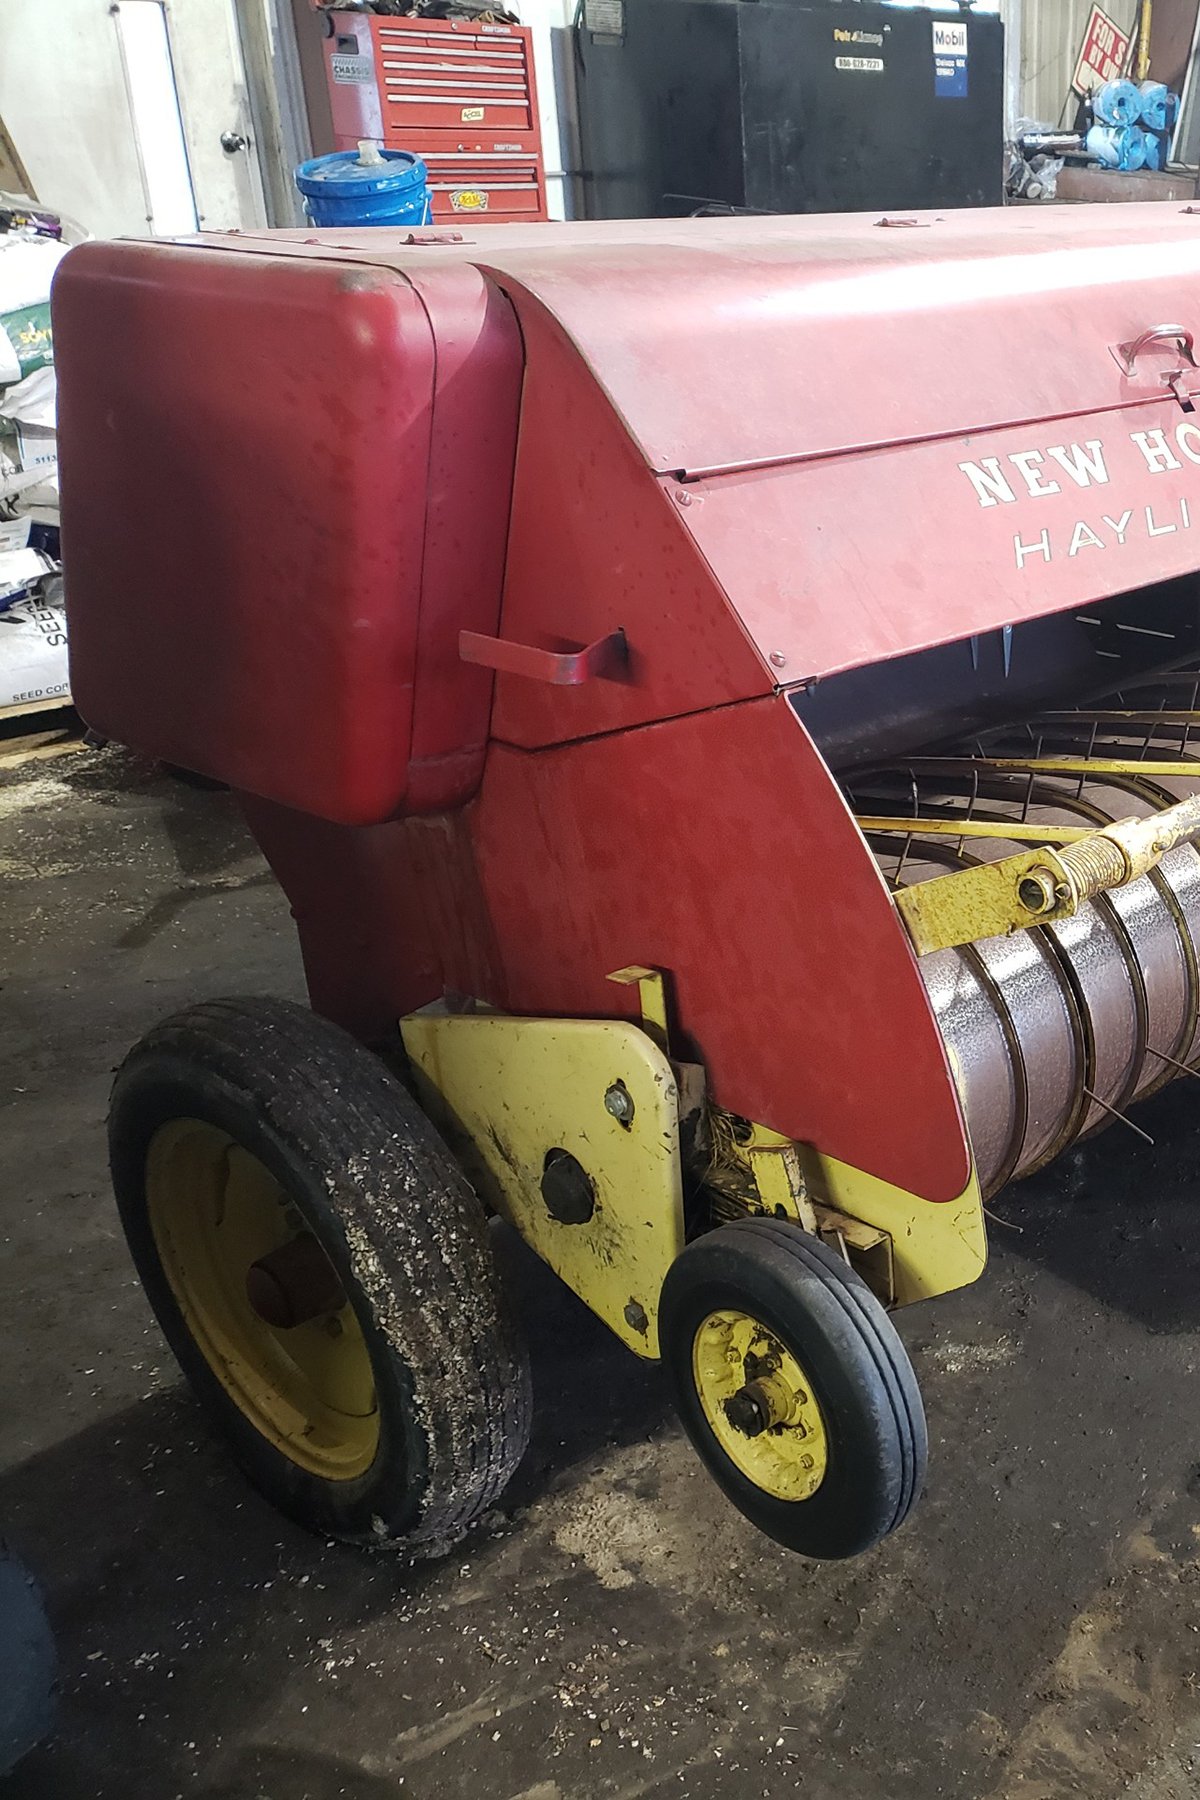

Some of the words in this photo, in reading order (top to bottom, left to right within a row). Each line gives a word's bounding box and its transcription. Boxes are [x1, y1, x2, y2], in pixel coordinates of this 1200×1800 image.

[935, 29, 965, 46] Mobil
[1092, 16, 1116, 57] FOR
[957, 439, 1110, 508] NEW
[12, 688, 43, 702] SEED
[45, 682, 69, 694] COR
